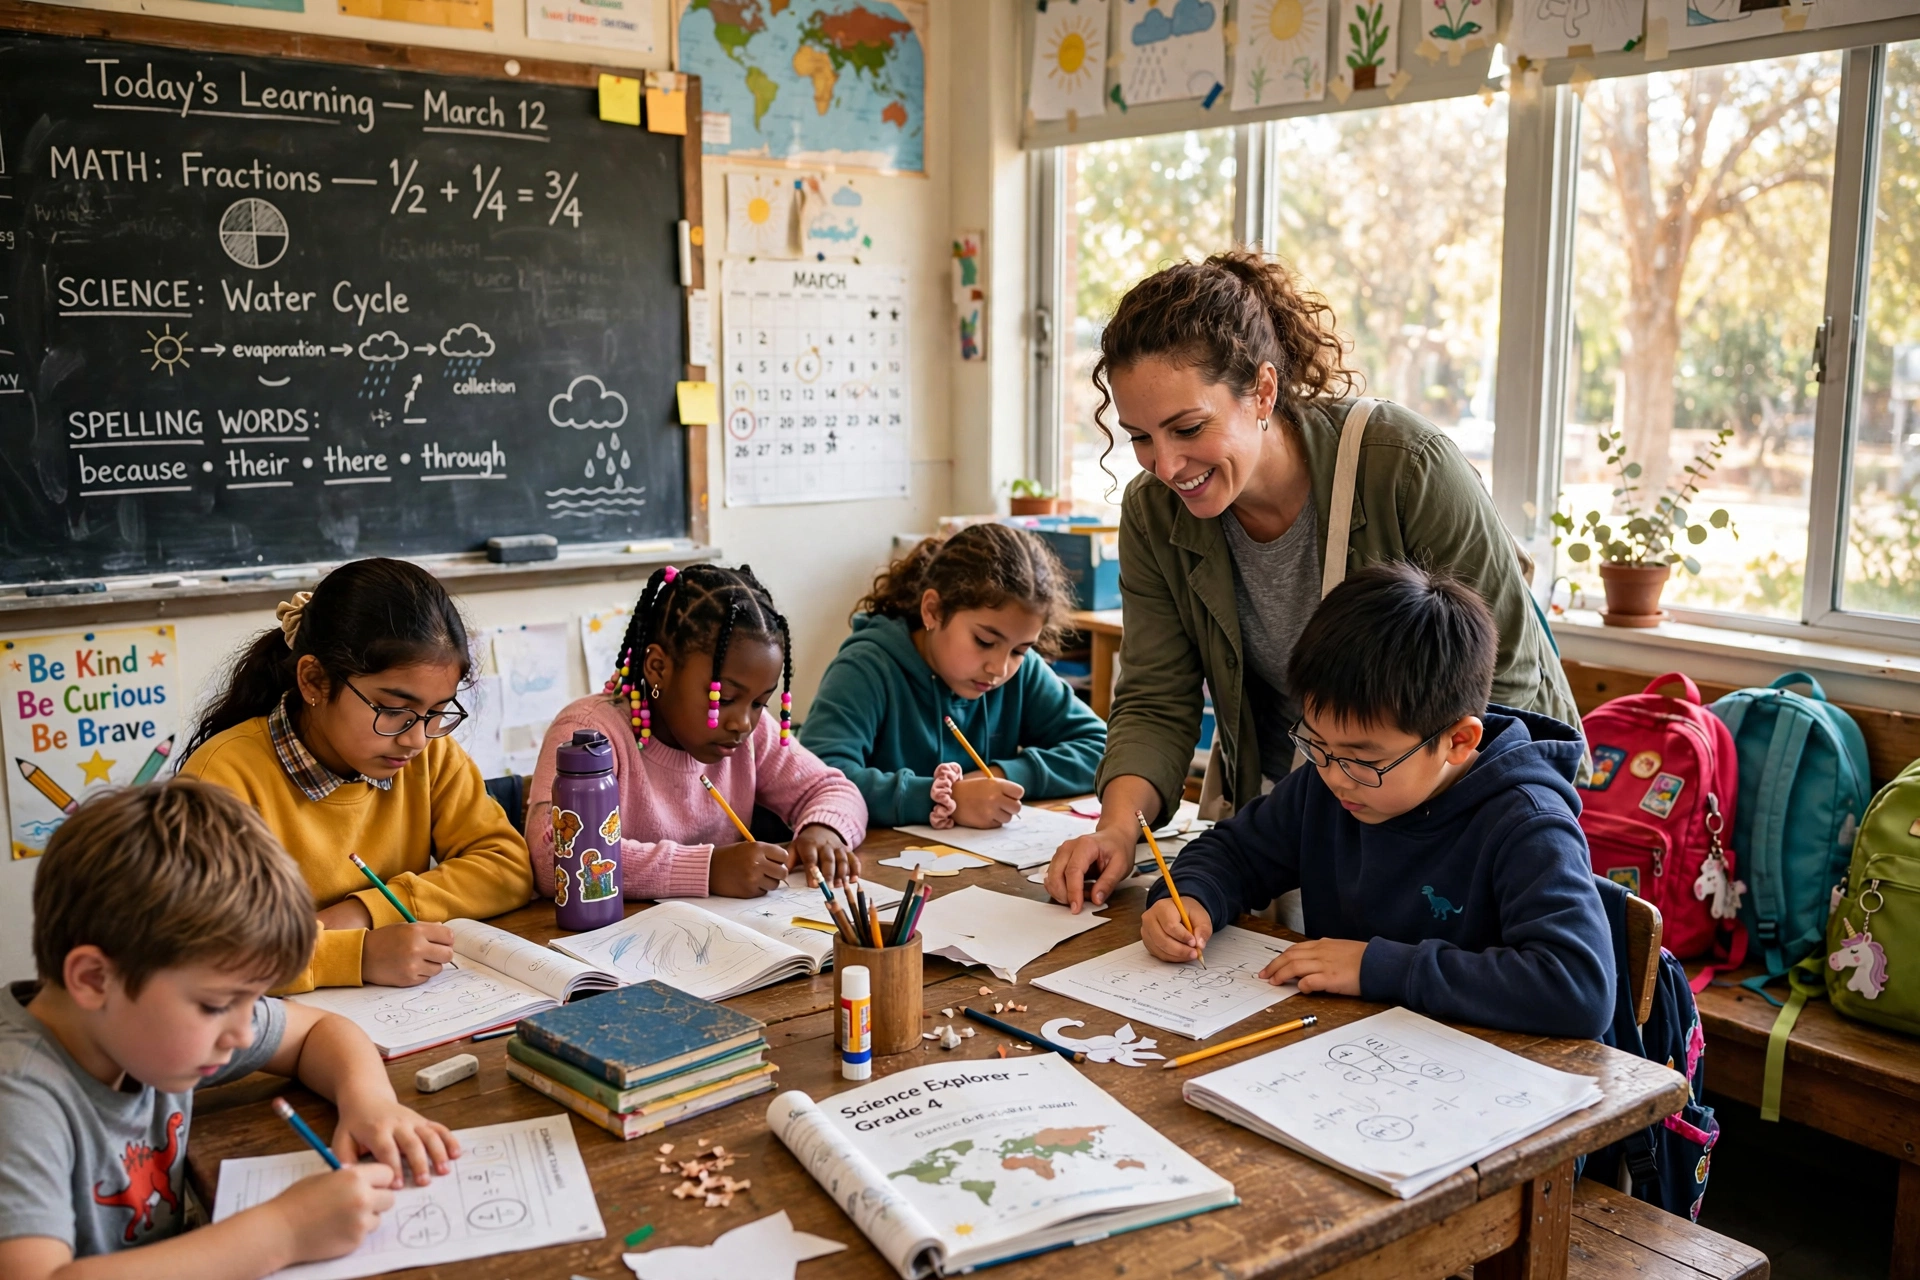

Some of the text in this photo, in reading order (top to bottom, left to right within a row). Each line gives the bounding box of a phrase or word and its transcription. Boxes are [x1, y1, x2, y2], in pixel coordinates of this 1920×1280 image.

[86, 59, 218, 118] Today's
[241, 71, 375, 133] Learning
[424, 88, 505, 128] March
[518, 100, 549, 131] 12
[51, 145, 162, 183] MATH:
[182, 151, 322, 193] Fractions
[58, 276, 410, 327] SCIENCE: Water Cycle
[232, 339, 327, 365] evaporation
[758, 331, 768, 346] 2
[759, 360, 768, 374] 5
[452, 377, 517, 395] collection
[69, 408, 321, 440] SPELLING WORDS:
[78, 454, 189, 484] because
[226, 448, 291, 478] their
[323, 444, 389, 474] there
[420, 439, 507, 478] through
[28, 644, 138, 684] Be Kind
[17, 683, 166, 720] Be Curious
[32, 717, 156, 753] Be Brave
[840, 1086, 922, 1119] Science
[923, 1070, 1011, 1093] Explorer
[854, 1105, 922, 1133] Grade
[928, 1098, 944, 1110] 4
